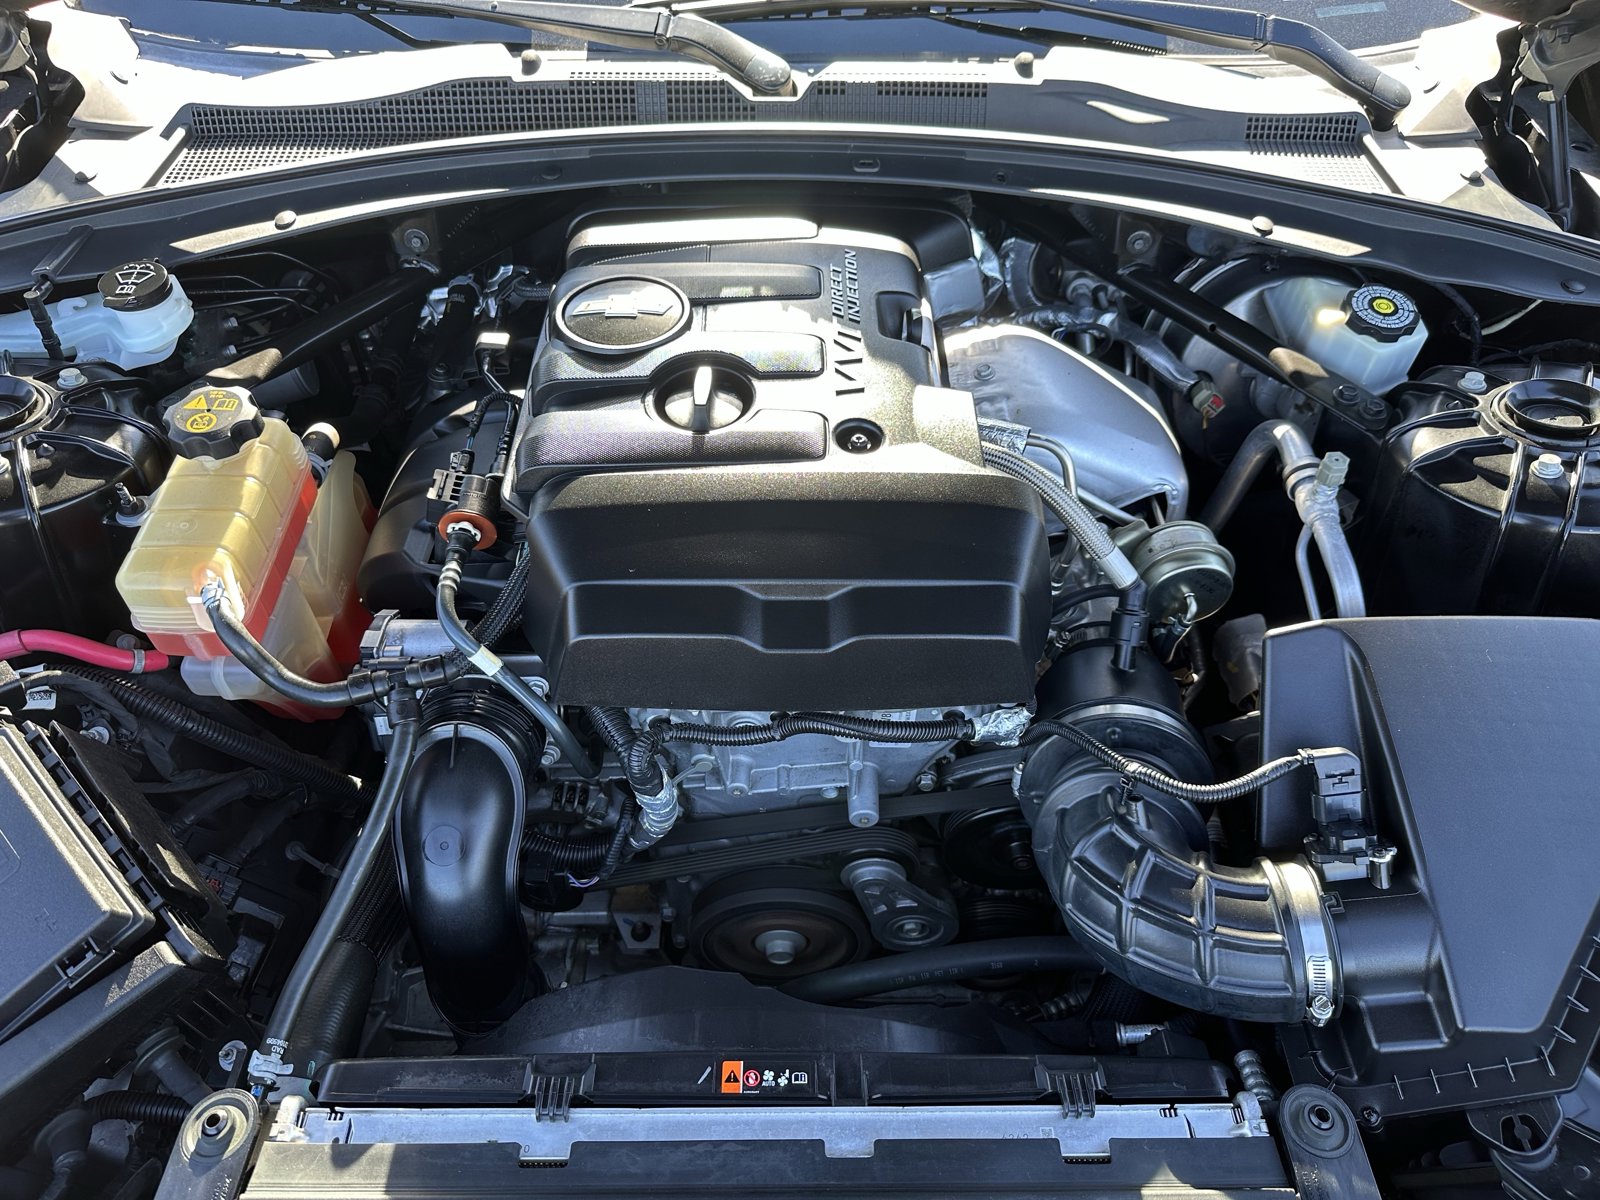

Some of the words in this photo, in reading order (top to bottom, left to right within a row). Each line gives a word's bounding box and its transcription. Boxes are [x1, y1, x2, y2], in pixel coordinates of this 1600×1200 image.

[830, 263, 844, 319] DIRECT
[844, 249, 860, 324] INJECTION
[833, 316, 865, 396] VVT
[271, 1045, 285, 1055] RAD
